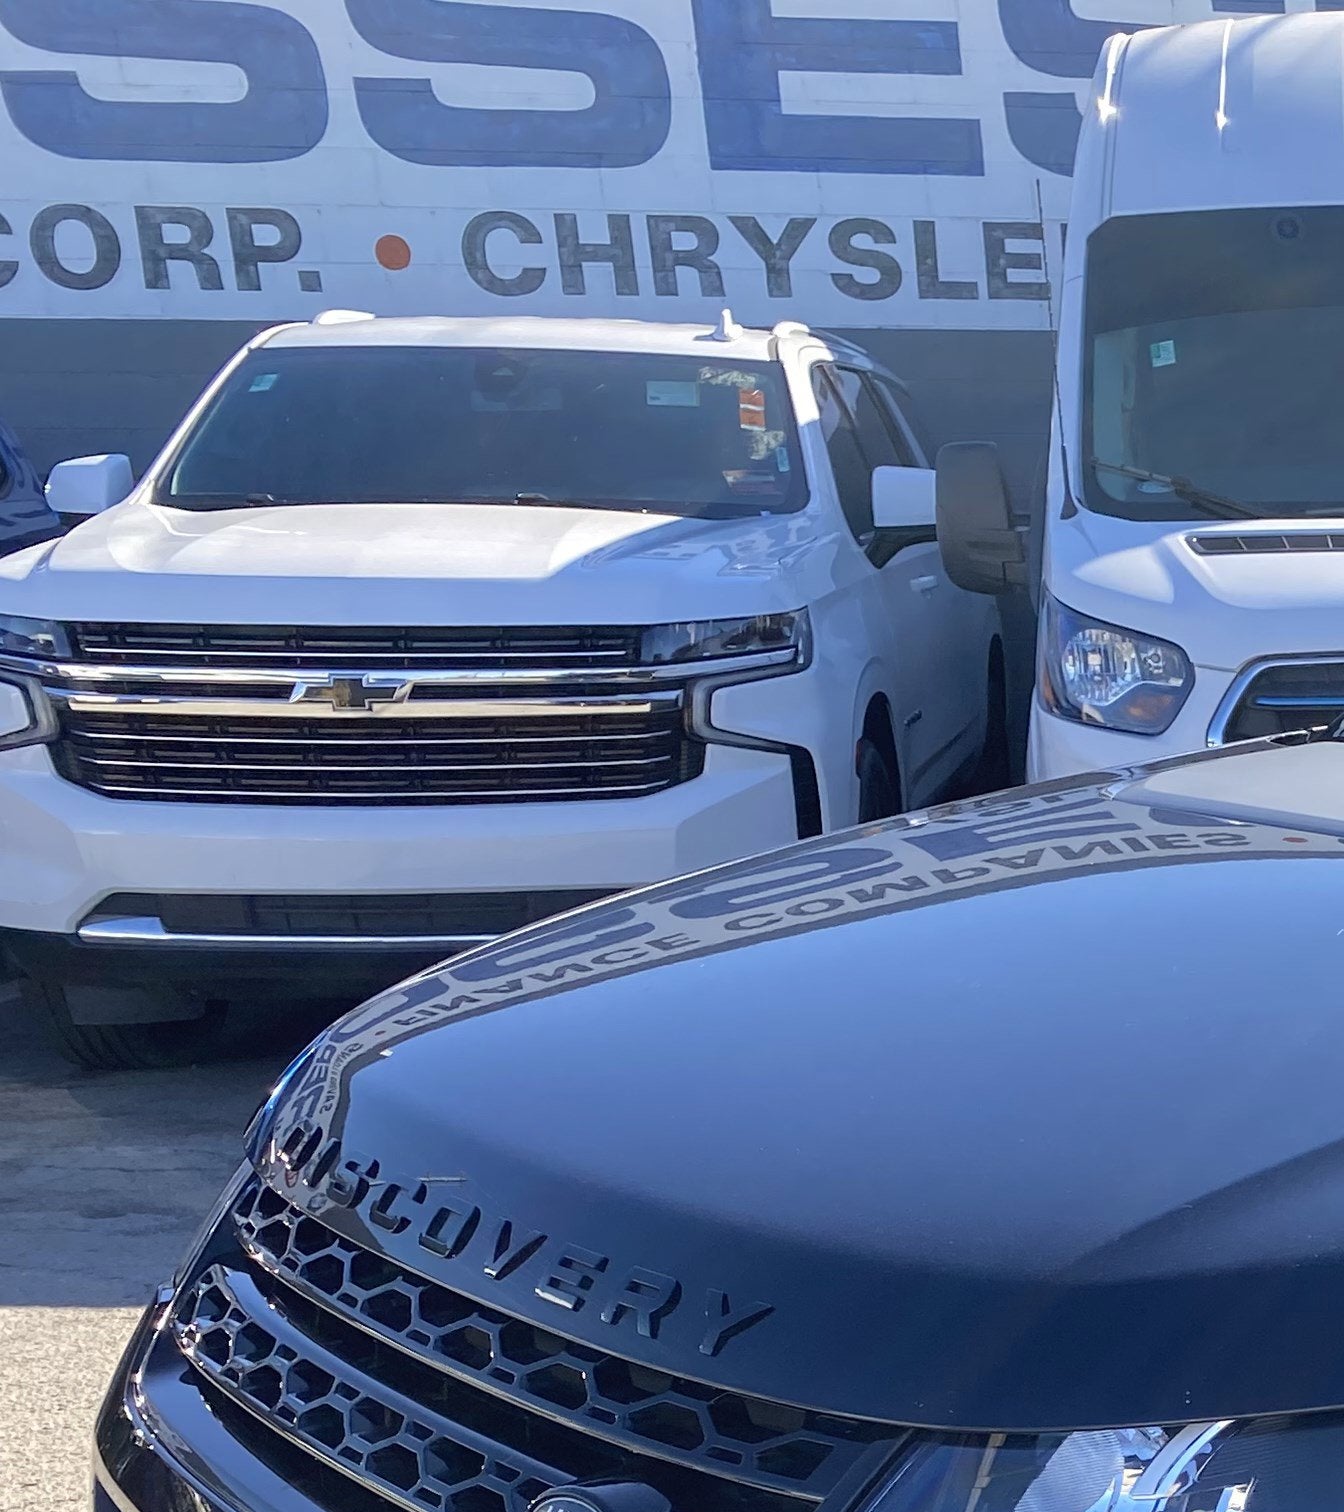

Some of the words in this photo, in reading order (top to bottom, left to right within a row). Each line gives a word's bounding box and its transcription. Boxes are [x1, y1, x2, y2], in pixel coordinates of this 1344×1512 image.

[0, 203, 323, 293] ORP.
[461, 211, 1067, 301] CHRYSLE
[277, 1125, 776, 1357] DISCOVERY
